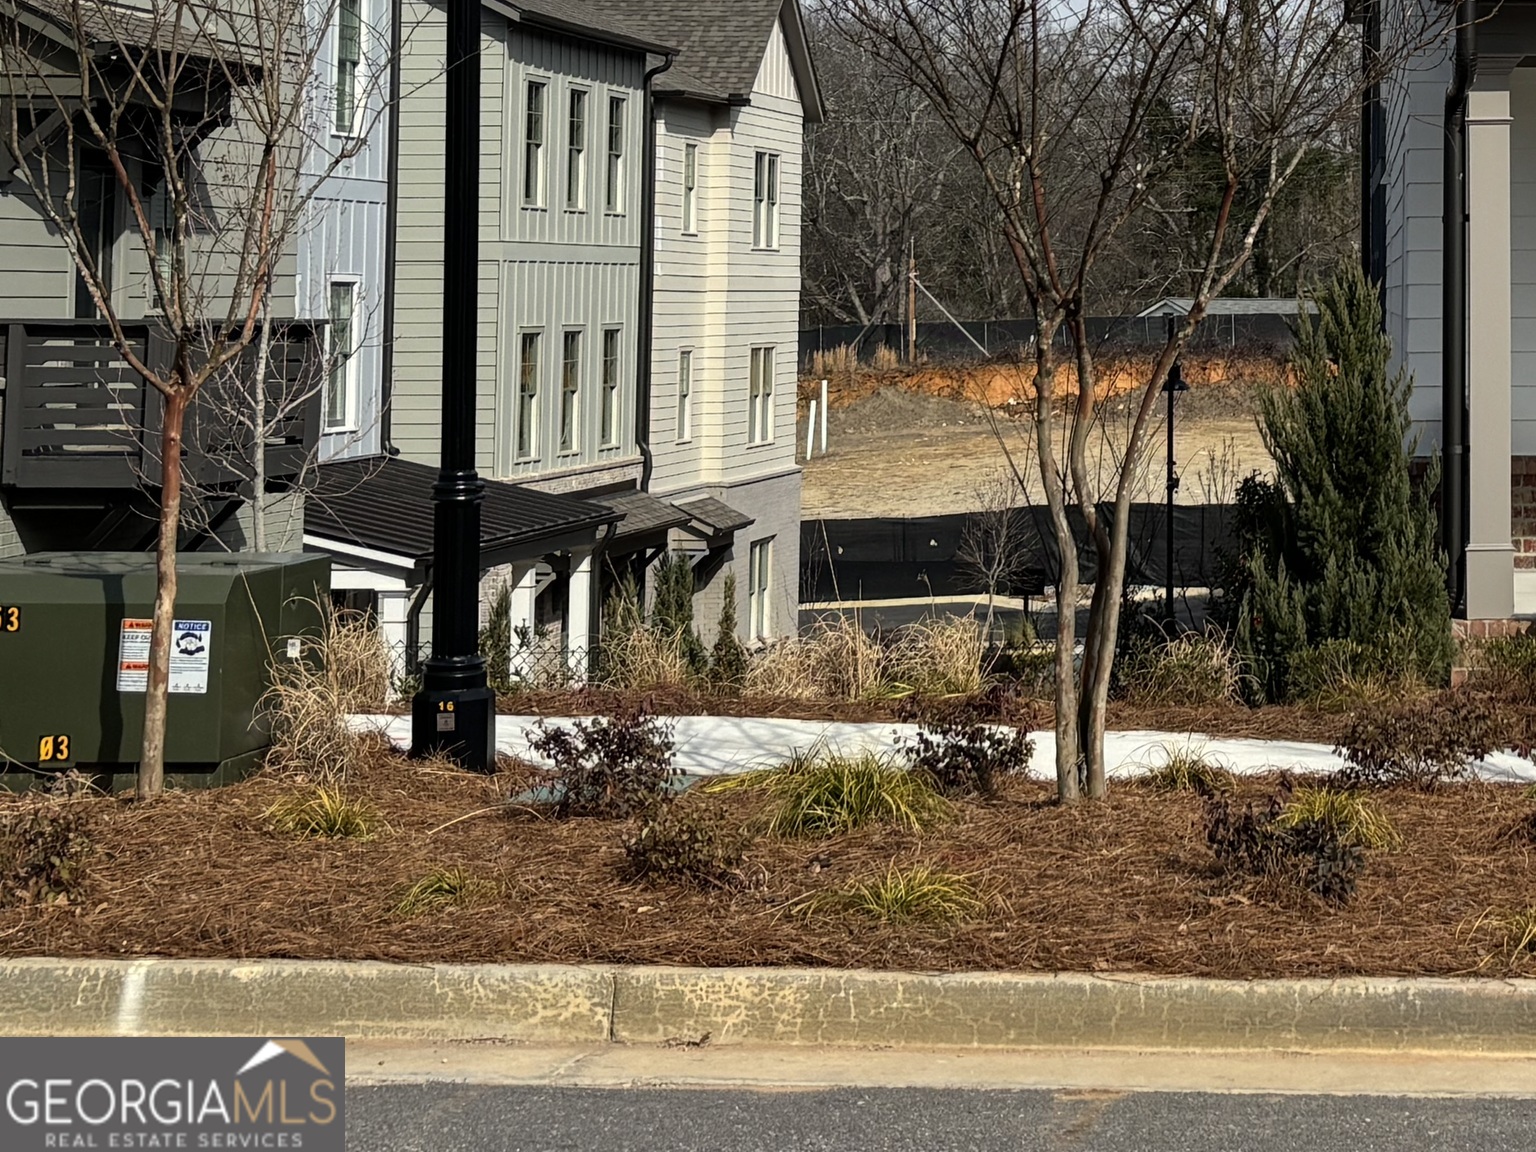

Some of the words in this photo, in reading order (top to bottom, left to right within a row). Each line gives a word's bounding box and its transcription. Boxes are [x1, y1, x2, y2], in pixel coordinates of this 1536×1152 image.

[0, 606, 20, 632] 3
[178, 622, 207, 630] NOTICE
[438, 701, 454, 711] 16
